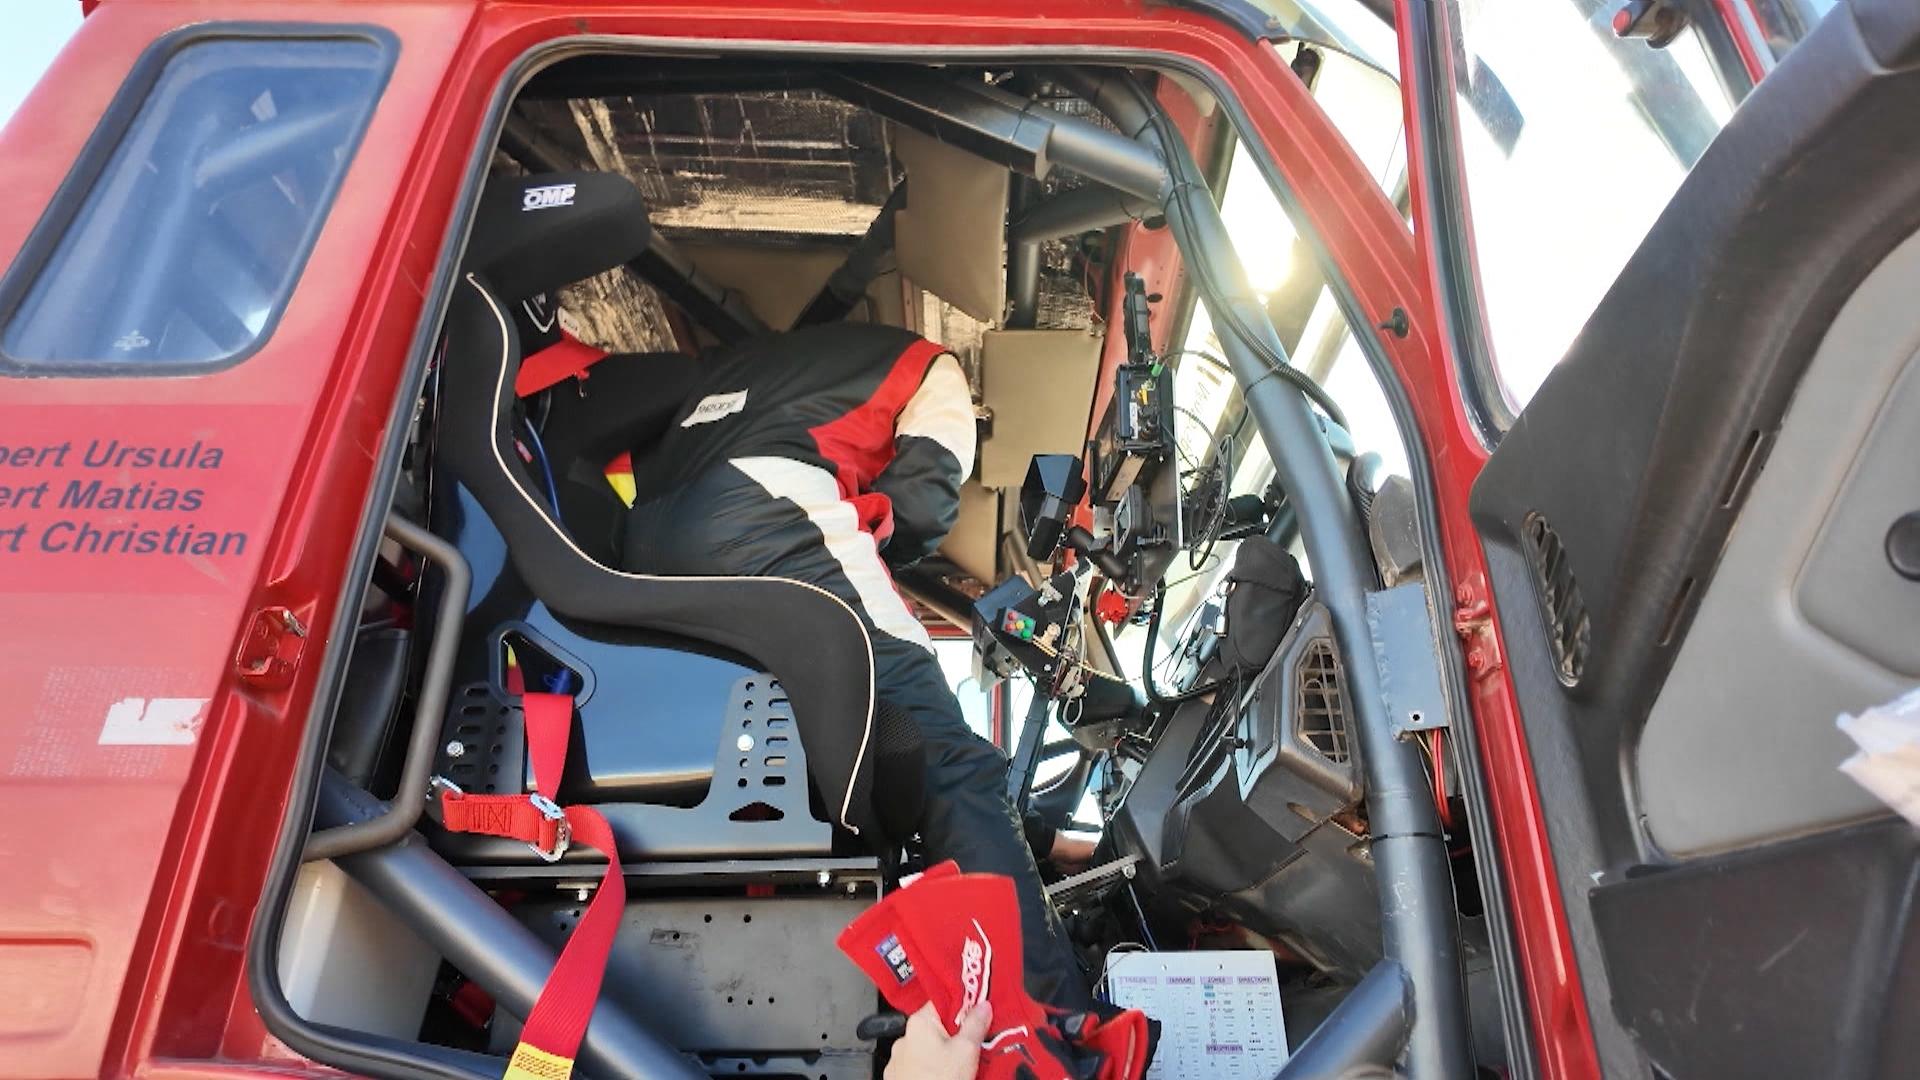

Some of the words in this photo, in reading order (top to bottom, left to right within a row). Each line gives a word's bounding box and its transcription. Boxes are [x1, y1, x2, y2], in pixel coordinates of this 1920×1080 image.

[521, 183, 577, 212] OMP
[83, 439, 224, 470] Ursula
[58, 479, 205, 512] Matias
[40, 521, 248, 556] Christian
